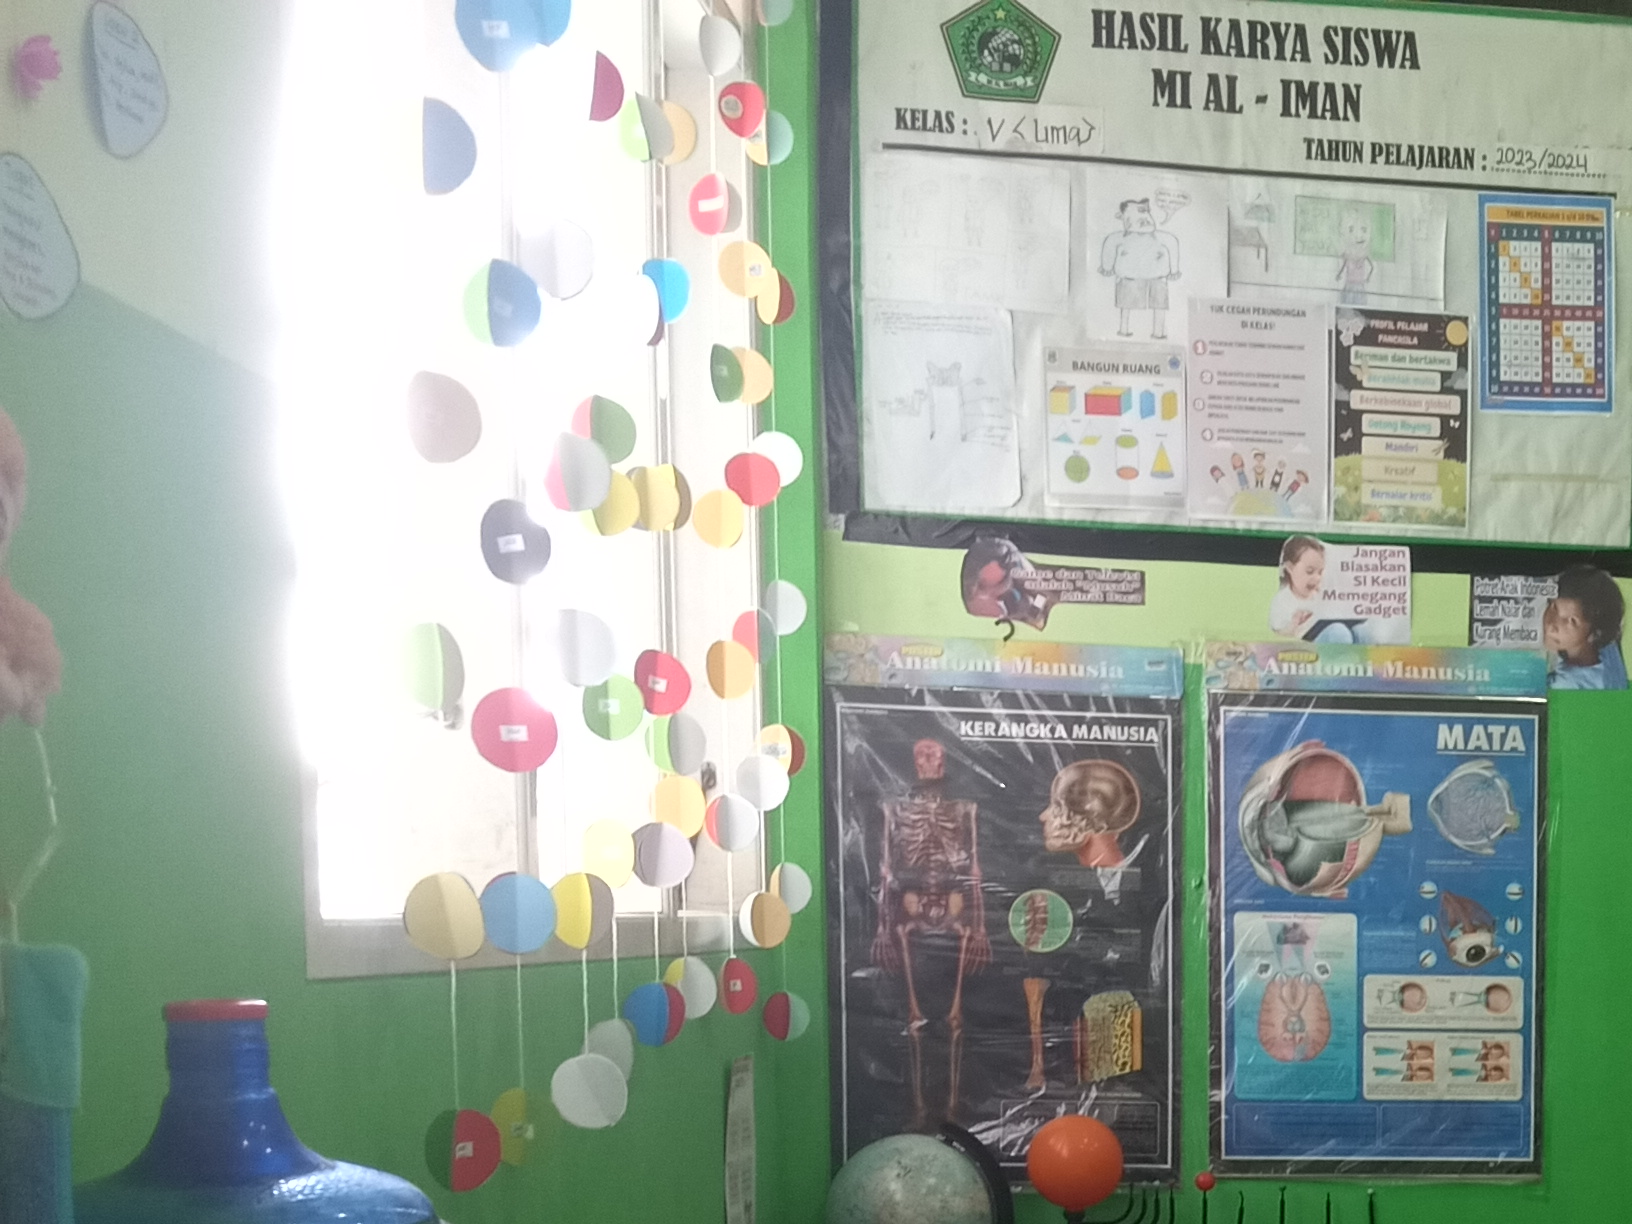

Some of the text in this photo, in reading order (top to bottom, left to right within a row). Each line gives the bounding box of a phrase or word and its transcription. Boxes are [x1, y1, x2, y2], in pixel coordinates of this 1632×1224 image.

[1091, 8, 1421, 70] HASIL KARYA SISWA
[1151, 68, 1192, 110] MI
[1202, 73, 1244, 115] AL
[1279, 78, 1362, 123] IMAN
[894, 107, 956, 135] KELAS
[1303, 137, 1364, 165] TAHUN
[1370, 141, 1476, 171] PELAJARAN
[1495, 147, 1589, 173] 2023/2024
[1370, 319, 1429, 332] PROFIL PELAJAR
[1391, 353, 1407, 363] dan
[1072, 360, 1161, 376] BANGUN RUANG
[1385, 442, 1418, 453] Mandiri
[1384, 465, 1415, 476] Kreatif
[1353, 546, 1407, 561] Jangan
[1055, 568, 1084, 580] dan
[1340, 561, 1407, 573] Biasakan
[1372, 574, 1407, 587] Kecil
[1475, 576, 1499, 592] Potret
[1500, 579, 1518, 594] Anak
[1322, 589, 1408, 604] Memegang
[1353, 603, 1408, 618] Gadget
[1475, 602, 1535, 618] Lemah Nalar dan
[1475, 624, 1538, 645] Kurang Membaca
[887, 651, 1125, 680] Anatomi Manusia
[1262, 657, 1491, 683] Anatomi Manusia
[959, 719, 1159, 743] KERANGKA MANUSIA
[1436, 723, 1526, 752] MATA
